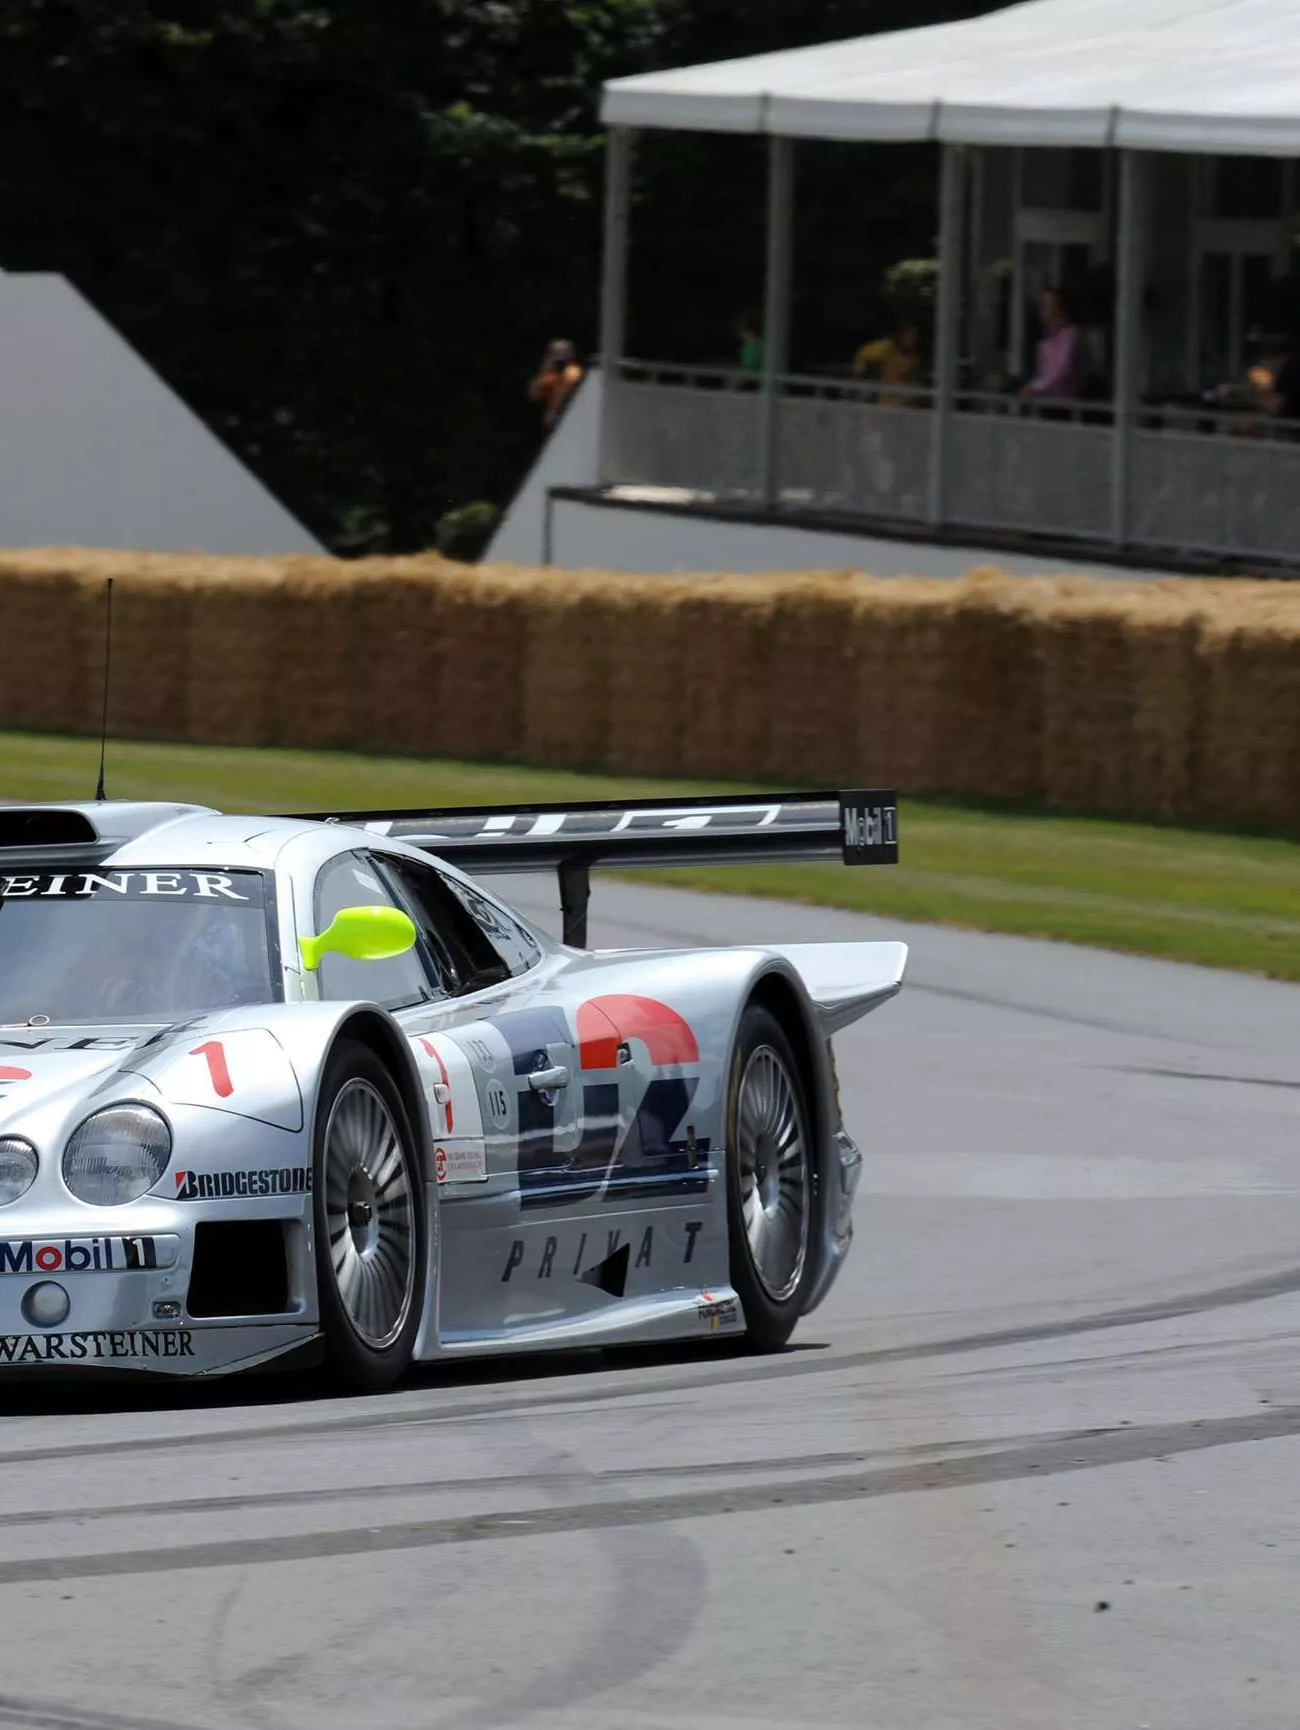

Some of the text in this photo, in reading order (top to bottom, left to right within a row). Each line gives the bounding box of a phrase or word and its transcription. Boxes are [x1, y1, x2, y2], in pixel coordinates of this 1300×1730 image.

[188, 1040, 234, 1098] 1
[487, 993, 711, 1211] D2
[488, 1090, 507, 1116] 115
[175, 1167, 313, 1200] BRIDGESTONE
[0, 1237, 112, 1273] Mobil
